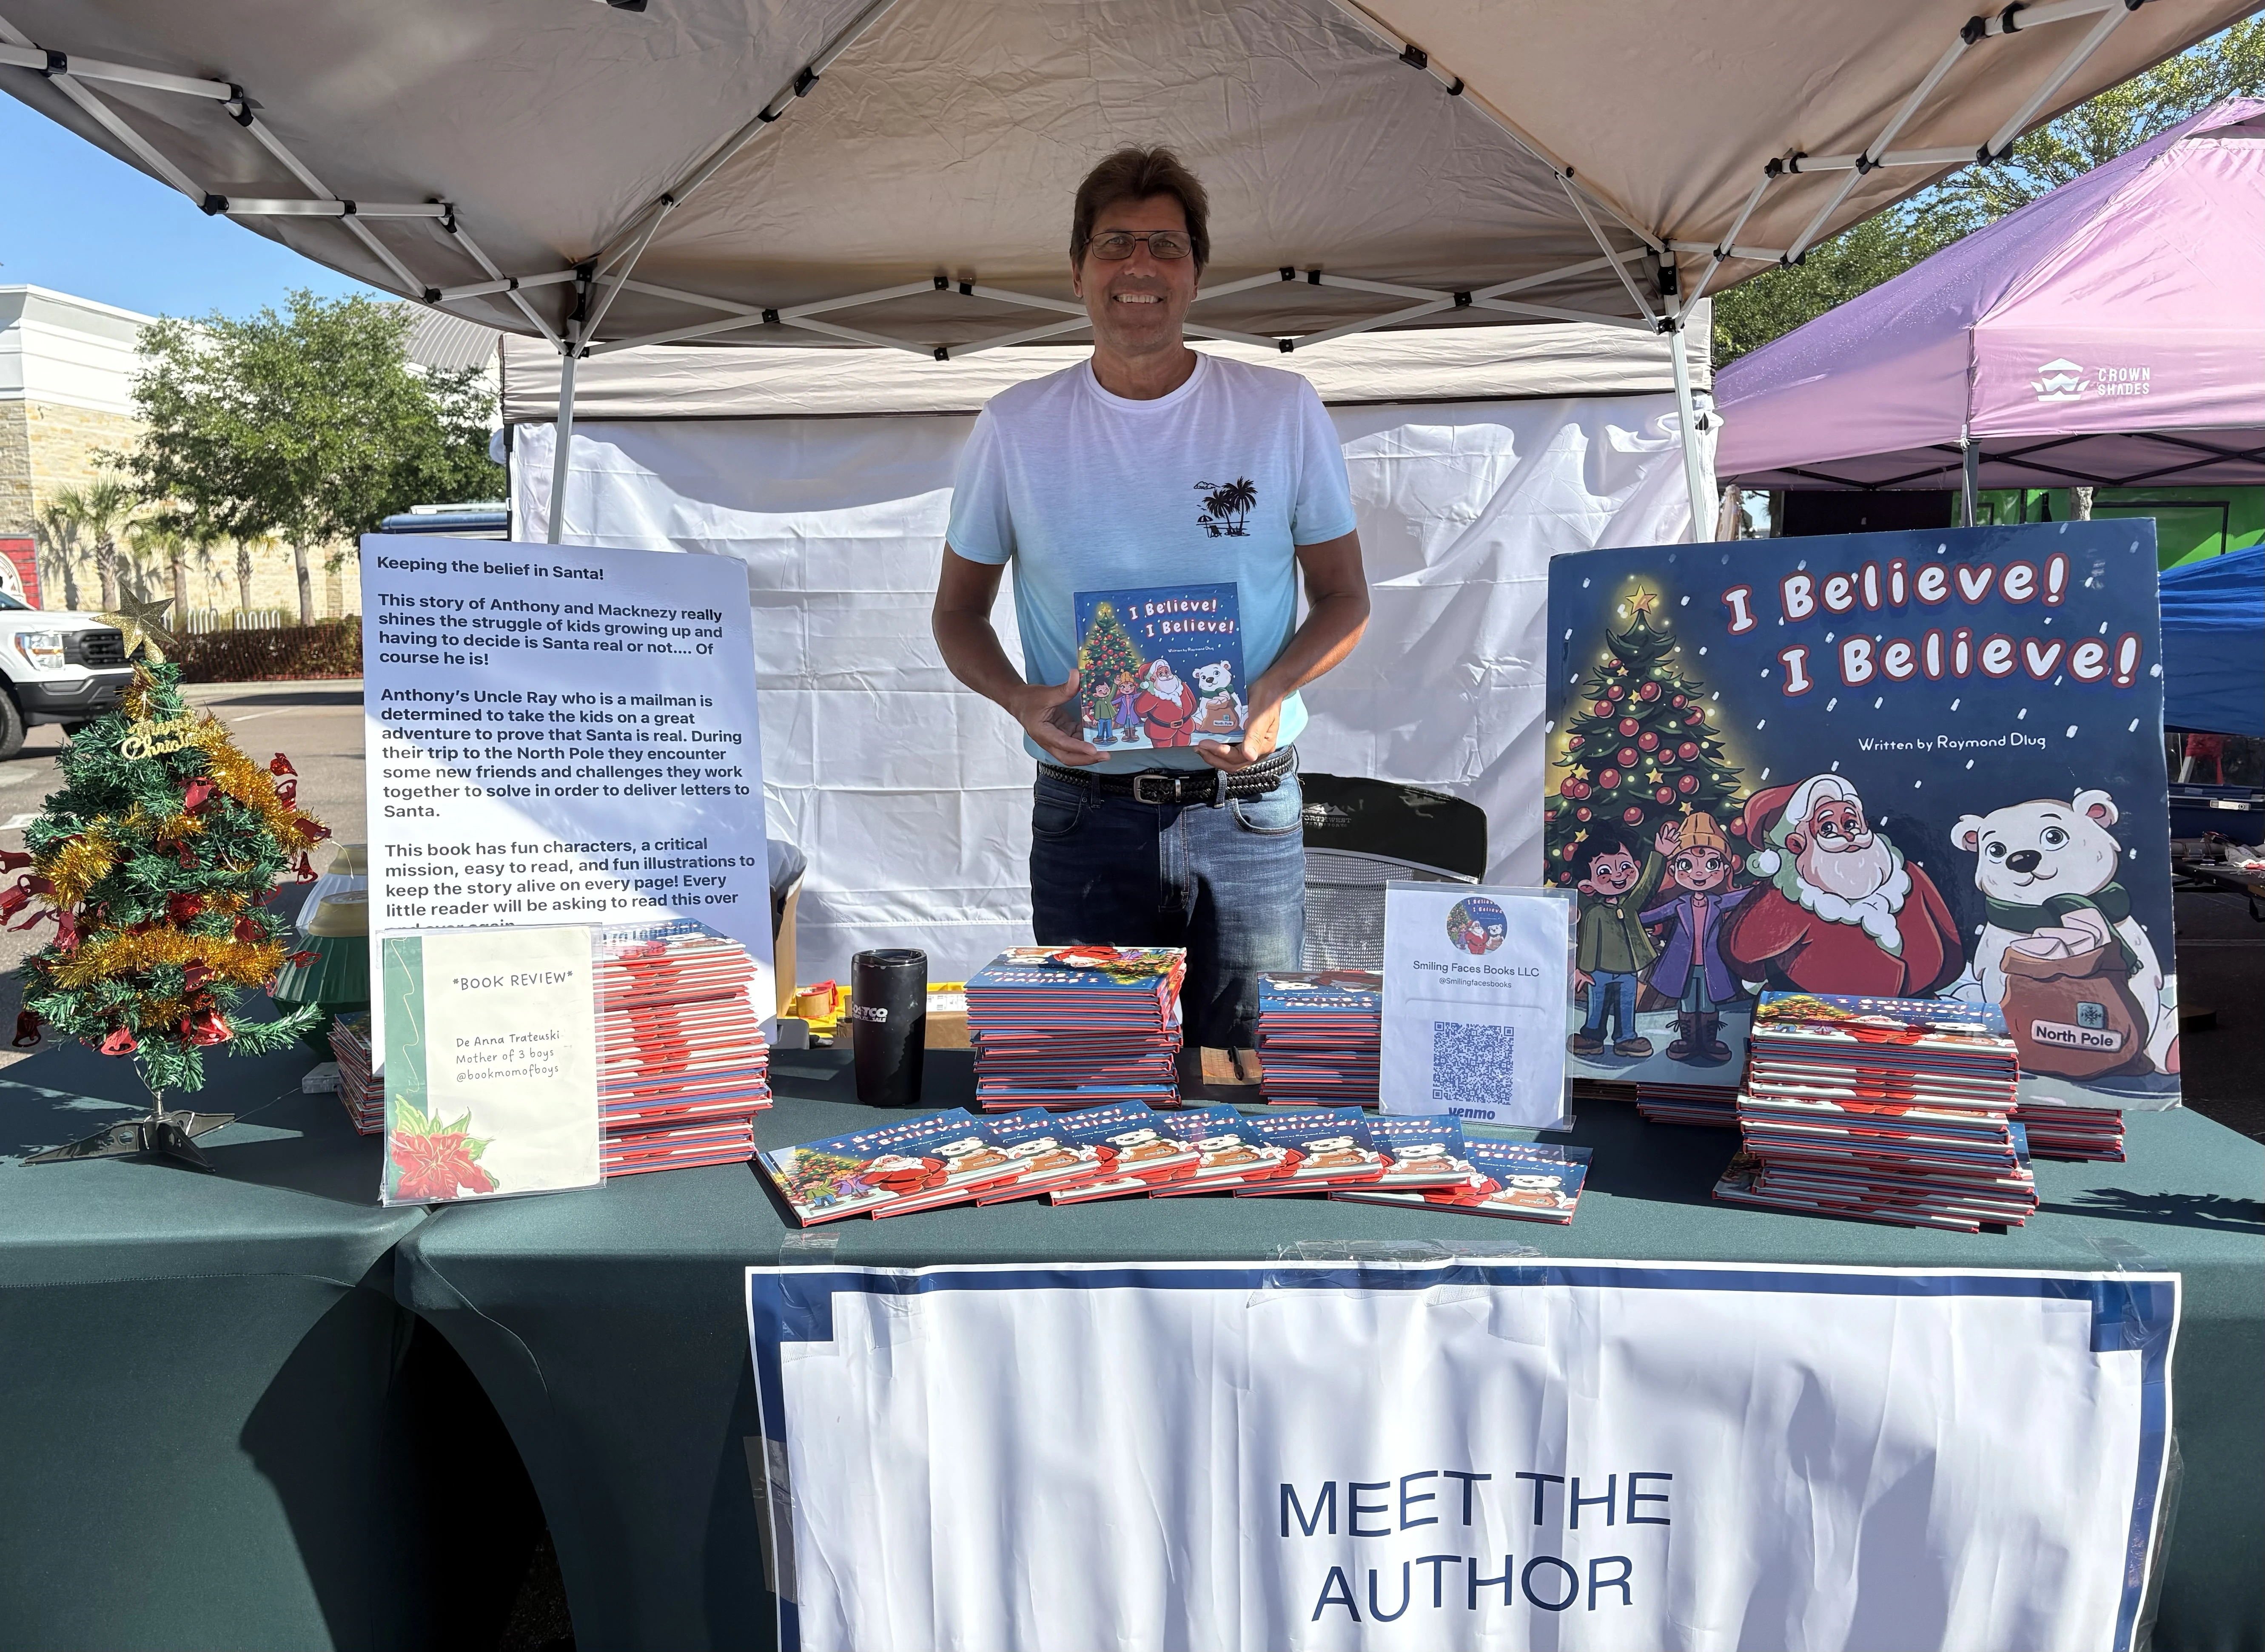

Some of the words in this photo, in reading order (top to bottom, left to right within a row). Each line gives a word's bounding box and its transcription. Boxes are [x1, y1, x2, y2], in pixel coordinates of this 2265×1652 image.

[2098, 367, 2150, 381] CROWN
[2098, 383, 2149, 396] SHADES
[377, 556, 447, 574] Keeping
[451, 560, 479, 573] the
[484, 561, 530, 576] belief
[534, 564, 548, 577] in
[553, 566, 604, 580] Santa!
[1724, 586, 1755, 634] I
[1783, 554, 2067, 620] Believe!
[378, 593, 415, 607] This
[419, 596, 464, 611] story
[469, 597, 486, 610] of
[490, 599, 560, 616] Anthony
[564, 603, 594, 615] and
[598, 604, 677, 621] Macknezy
[681, 608, 722, 623] really
[1129, 606, 1138, 620] I
[1145, 598, 1217, 616] Believe!
[379, 612, 436, 626] shines
[439, 614, 468, 627] the
[472, 617, 542, 632] struggle
[546, 619, 563, 631] of
[567, 620, 601, 633] kids
[604, 623, 668, 638] growing
[672, 627, 691, 639] up
[695, 626, 722, 638] and
[1146, 624, 1154, 637] I
[1162, 619, 1234, 635] Believe!
[379, 631, 437, 648] having
[441, 634, 459, 646] to
[463, 634, 520, 648] decide
[524, 635, 538, 648] is
[543, 637, 589, 650] Santa
[593, 640, 623, 651] real
[627, 643, 644, 652] or
[696, 643, 714, 655] Of
[379, 653, 439, 664] course
[444, 651, 465, 665] he
[469, 652, 489, 665] is!
[1780, 645, 1812, 695] I
[1838, 631, 2139, 686] Believe!
[474, 690, 522, 703] Uncle
[527, 691, 558, 707] Ray
[561, 692, 596, 705] who
[600, 692, 613, 705] is
[617, 696, 627, 705] a
[631, 693, 696, 707] mailman
[700, 694, 713, 707] is
[381, 707, 482, 721] determined
[486, 710, 504, 722] to
[507, 709, 544, 722] take
[548, 710, 576, 722] the
[580, 710, 613, 723] kids
[617, 714, 637, 723] on
[641, 714, 650, 723] a
[654, 713, 695, 726] great
[382, 726, 471, 740] adventure
[475, 728, 493, 740] to
[497, 731, 544, 743] prove
[548, 728, 582, 741] that
[586, 729, 632, 741] Santa
[636, 729, 650, 742] is
[653, 730, 687, 742] real.
[692, 730, 742, 745] During
[1858, 737, 1913, 751] Written
[1917, 739, 1933, 752] by
[1937, 735, 2006, 751] Raymond
[2010, 732, 2046, 750] Dlug
[382, 745, 424, 759] their
[427, 745, 459, 762] trip
[462, 747, 480, 759] to
[484, 746, 513, 759] the
[517, 747, 565, 759] North
[570, 747, 604, 759] Pole
[608, 747, 644, 762] they
[647, 749, 727, 760] encounter
[383, 768, 431, 778] some
[436, 768, 472, 778] new
[476, 765, 537, 778] friends
[541, 765, 572, 778] and
[576, 765, 663, 780] challenges
[666, 765, 701, 780] they
[704, 765, 743, 777] work
[383, 785, 460, 801] together
[464, 785, 482, 797] to
[486, 784, 531, 797] solve
[535, 783, 550, 796] in
[554, 784, 599, 796] order
[602, 785, 619, 796] to
[624, 783, 677, 796] deliver
[681, 783, 731, 796] letters
[734, 784, 749, 795] to
[384, 805, 440, 818] Santa.
[385, 843, 423, 857] This
[427, 842, 471, 856] book
[476, 842, 507, 855] has
[510, 842, 538, 854] fun
[543, 841, 636, 854] characters,
[641, 842, 650, 851] a
[654, 837, 707, 851] critical
[386, 862, 459, 878] mission,
[464, 864, 505, 877] easy
[509, 862, 527, 873] to
[531, 859, 573, 875] read,
[578, 858, 609, 871] and
[613, 858, 640, 870] fun
[644, 855, 736, 870] illustrations
[739, 856, 755, 866] to
[386, 884, 429, 899] keep
[433, 882, 462, 895] the
[467, 882, 512, 896] story
[517, 879, 556, 893] alive
[560, 881, 580, 891] on
[585, 879, 630, 892] every
[634, 875, 678, 891] page!
[683, 875, 727, 888] Every
[387, 903, 426, 917] little
[431, 901, 489, 916] reader
[493, 899, 521, 913] will
[527, 899, 547, 912] be
[552, 896, 607, 912] asking
[611, 897, 627, 908] to
[632, 893, 667, 907] read
[671, 892, 701, 906] this
[704, 894, 738, 904] over
[1413, 960, 1448, 974] Smiling
[1451, 962, 1481, 973] Faces
[1483, 964, 1515, 975] Books
[1517, 967, 1539, 977] LLC
[1439, 977, 1512, 989] @Smilingfacesbooks
[852, 1004, 888, 1018] OSTCO
[456, 1038, 470, 1048] De
[474, 1036, 504, 1045] Anna
[509, 1030, 560, 1043] Trateuski
[2036, 1026, 2076, 1043] North
[2081, 1032, 2114, 1046] Pole
[456, 1053, 497, 1064] Mother
[502, 1050, 515, 1061] of
[519, 1049, 525, 1059] 3
[530, 1048, 554, 1061] boys
[456, 1064, 559, 1082] @bookmomofboys
[1448, 1107, 1496, 1120] venmo
[851, 1117, 944, 1143] Believe!
[1280, 1470, 1492, 1538] MEET
[1515, 1471, 1673, 1530] THE
[1311, 1554, 1633, 1622] AUTHOR
